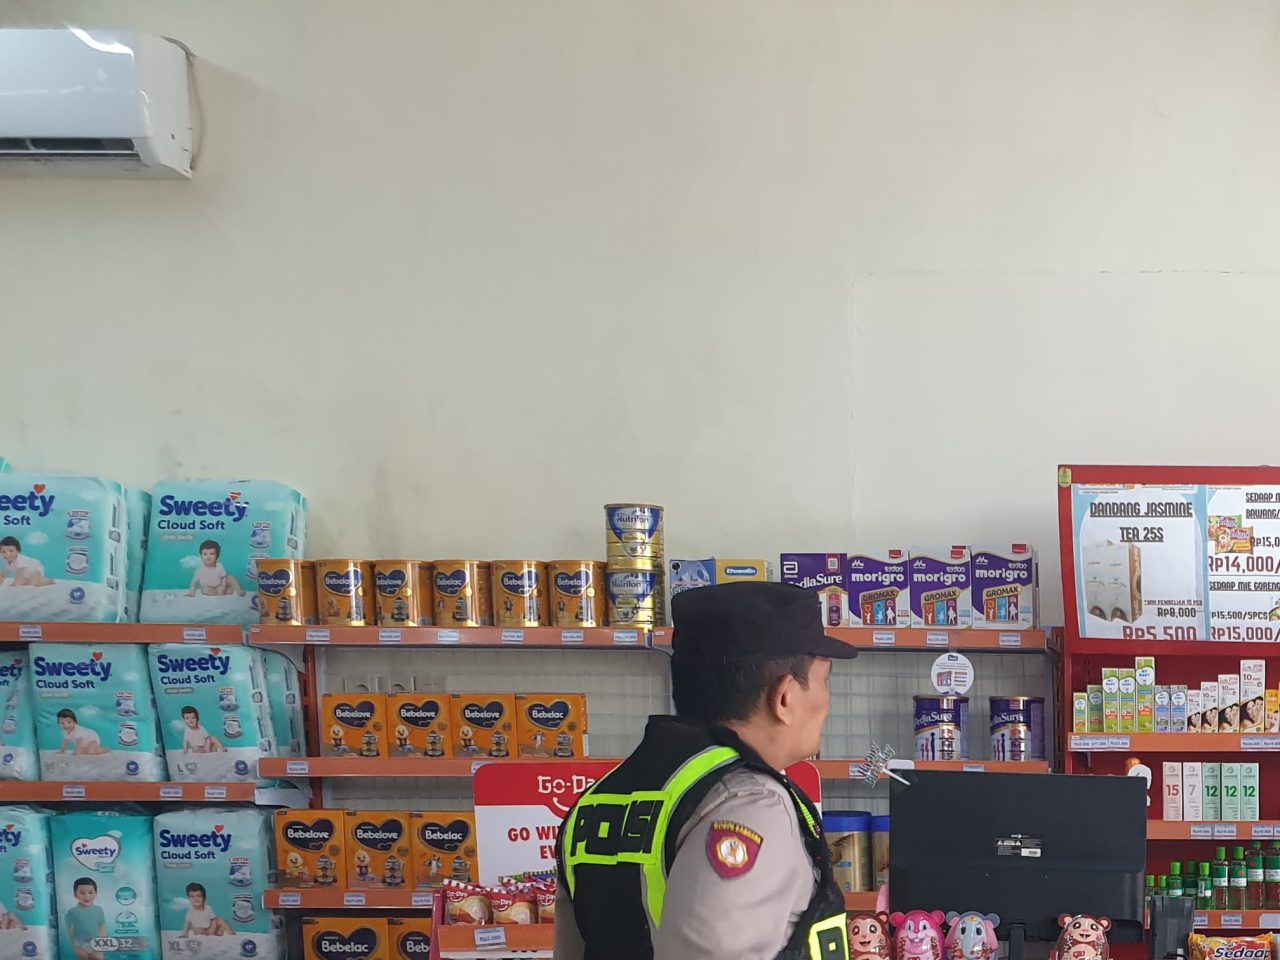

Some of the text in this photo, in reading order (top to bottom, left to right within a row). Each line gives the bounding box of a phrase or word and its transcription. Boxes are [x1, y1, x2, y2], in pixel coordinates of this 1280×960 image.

[1246, 493, 1273, 503] SEDAAP
[159, 494, 248, 522] Sweety
[1090, 502, 1193, 517] DANDANG JASMINE
[157, 519, 226, 531] Cloud Soft
[1120, 527, 1164, 542] TEA 25S
[851, 571, 905, 584] morigro
[913, 571, 967, 584] morigro
[975, 568, 1028, 581] morigro
[1209, 582, 1235, 591] SEDAAP
[1238, 582, 1252, 591] MIE
[1254, 582, 1280, 591] GORENG
[862, 590, 896, 601] GROMAX
[924, 590, 959, 601] GROMAX
[986, 587, 1020, 599] GROMAX
[33, 655, 112, 682] Sweety
[157, 654, 230, 675] Sweety
[36, 679, 96, 689] Cloud Soft
[160, 674, 216, 685] Cloud Soft
[335, 709, 371, 719] Bebelove
[400, 708, 436, 718] Bebelove
[464, 709, 500, 719] Bebelove
[531, 709, 564, 720] Bebelac
[1166, 784, 1179, 796] 15
[1188, 784, 1196, 796] 7
[1205, 785, 1218, 797] 12
[1224, 785, 1237, 797] 12
[1243, 785, 1256, 797] 12
[287, 829, 330, 839] Bebelove
[356, 829, 398, 839] Bebelove
[425, 830, 463, 840] Bebelac
[508, 827, 529, 842] GO
[159, 829, 232, 852] Sweety
[75, 845, 117, 858] Sweety
[160, 850, 216, 860] Cloud Soft
[93, 938, 117, 949] XXL
[321, 941, 368, 953] Bebelac
[1214, 946, 1270, 960] Sedaap
